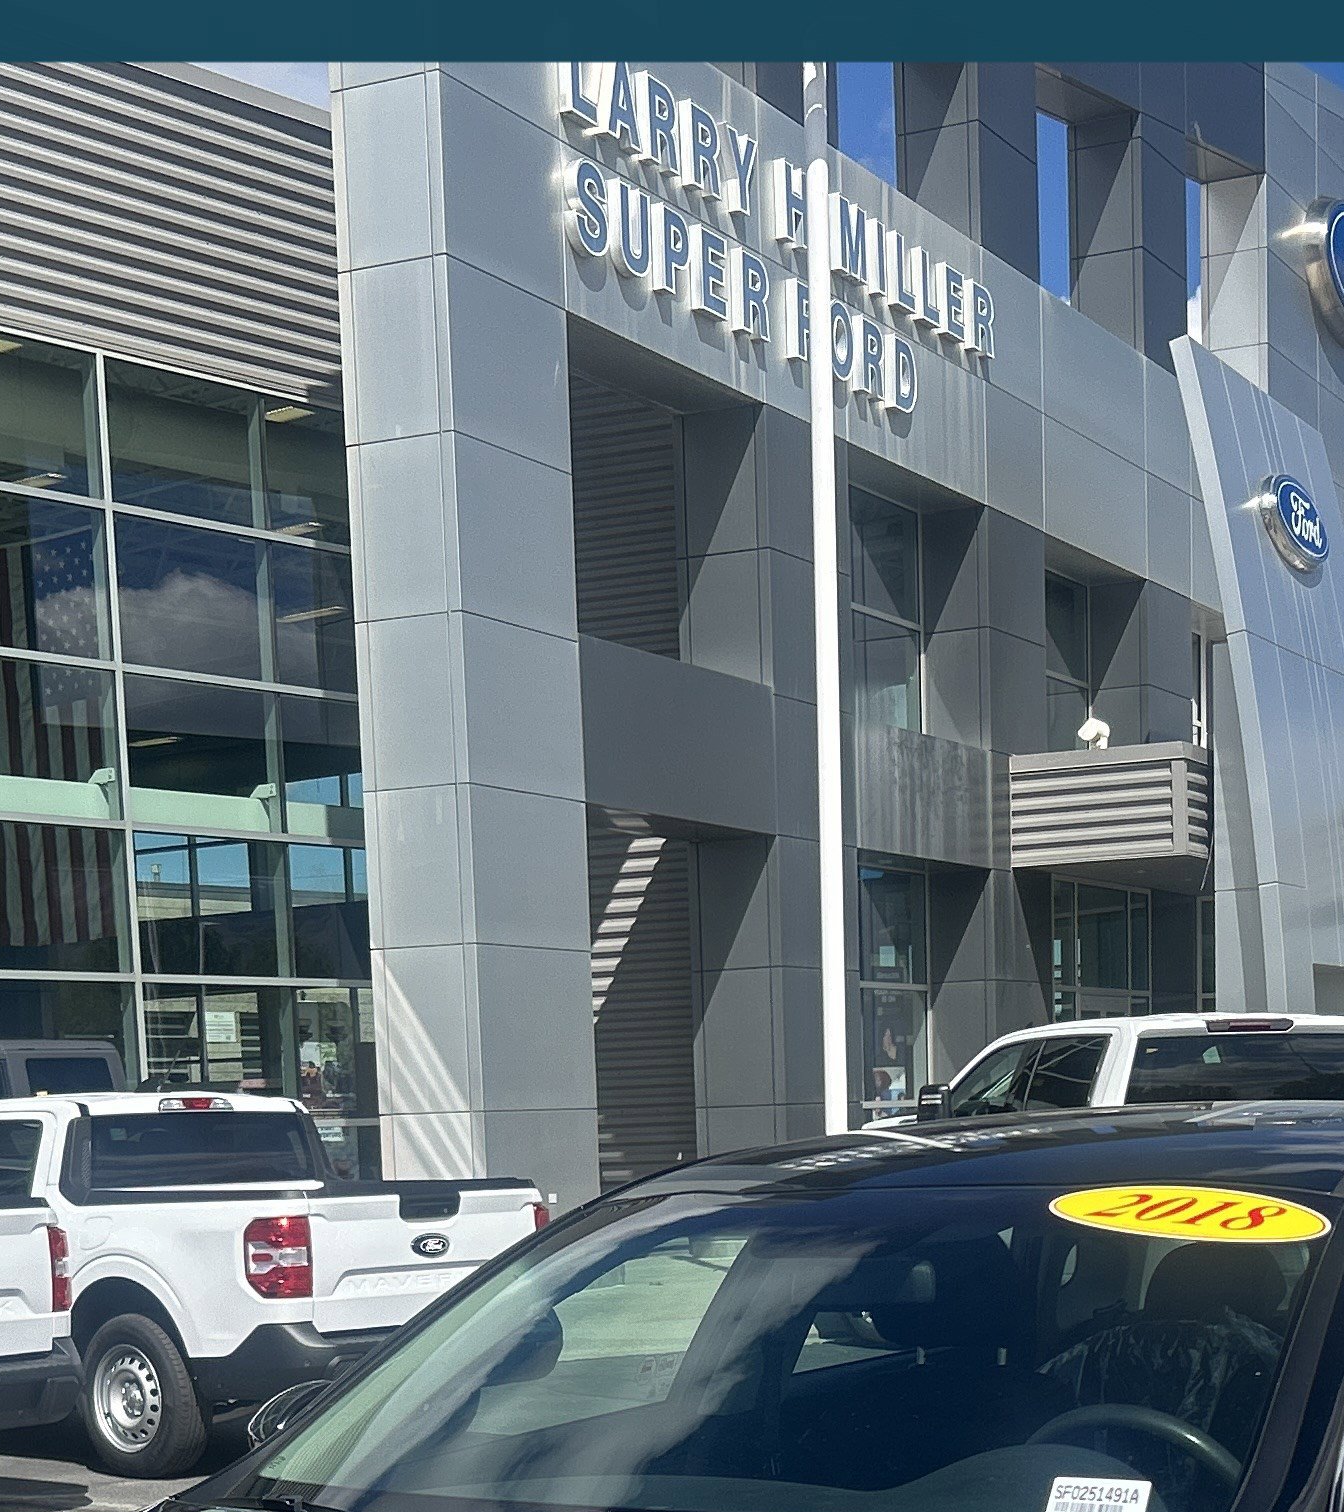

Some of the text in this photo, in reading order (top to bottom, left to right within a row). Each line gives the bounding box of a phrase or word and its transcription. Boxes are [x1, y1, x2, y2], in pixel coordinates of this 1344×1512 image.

[559, 62, 996, 360] LARRY H MILLER
[563, 157, 918, 414] SUPER FORD
[1290, 491, 1323, 549] Ford
[1082, 1193, 1288, 1231] 2018
